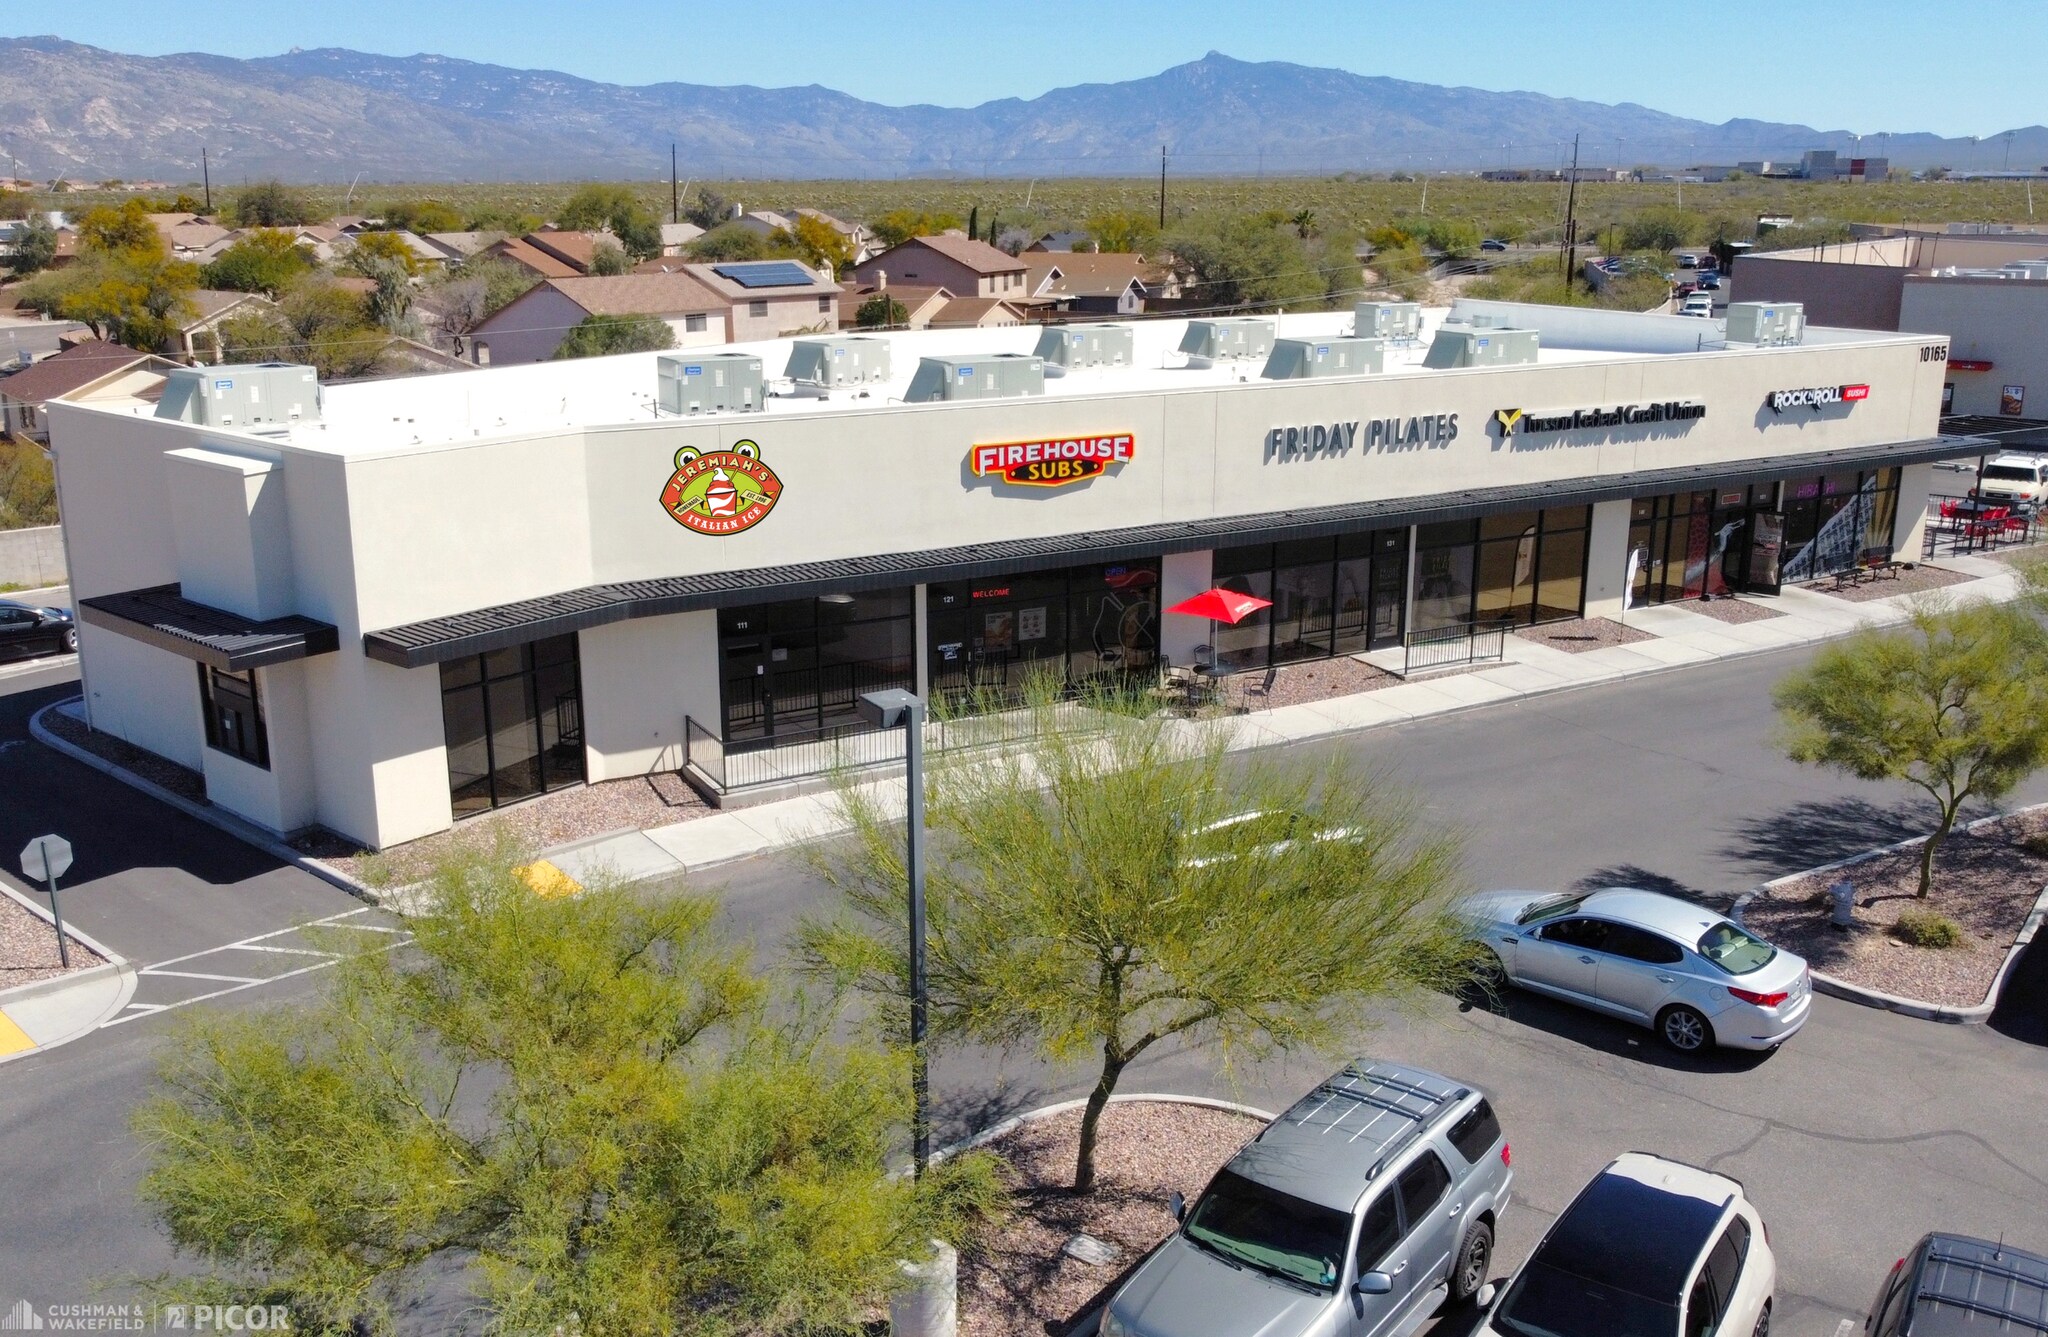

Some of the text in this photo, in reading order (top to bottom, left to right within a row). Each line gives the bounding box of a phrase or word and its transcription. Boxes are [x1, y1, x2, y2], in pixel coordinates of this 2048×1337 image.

[1919, 345, 1947, 363] 10165
[1774, 390, 1809, 411] ROCK
[1813, 388, 1842, 409] ROLL
[1846, 388, 1866, 398] SUSHI
[1623, 402, 1664, 425] Credit
[1664, 400, 1706, 421] Union
[1370, 413, 1459, 446] PILATES
[979, 436, 1130, 477] FIREHOUSE
[672, 456, 769, 491] JEREMIAH'S
[1028, 460, 1084, 480] SUBS
[1797, 482, 1836, 498] HIBAHI
[687, 506, 762, 531] ITALIAN ICE
[972, 588, 1010, 598] WELCOME
[737, 621, 748, 629] 111
